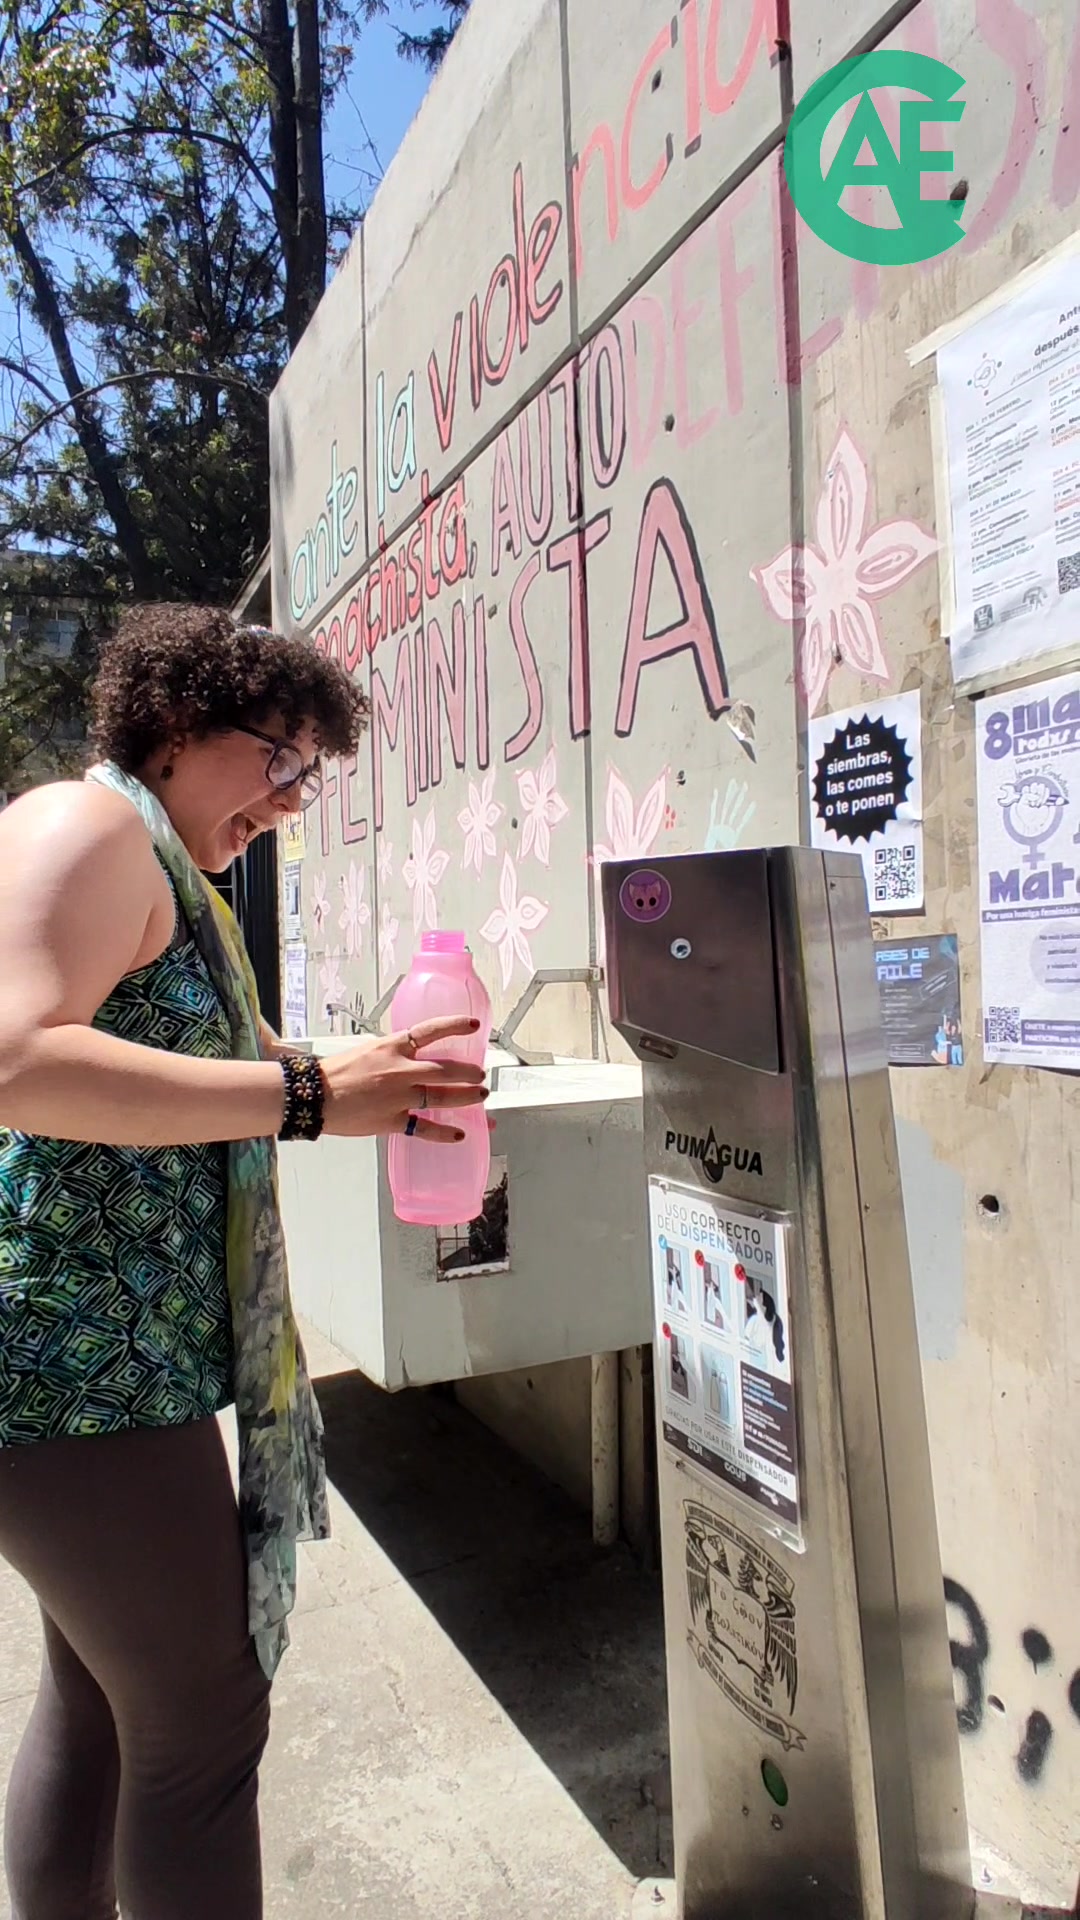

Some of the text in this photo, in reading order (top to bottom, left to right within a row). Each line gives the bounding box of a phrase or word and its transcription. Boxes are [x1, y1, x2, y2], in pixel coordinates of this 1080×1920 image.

[291, 0, 789, 621] ante la violencia
[320, 477, 732, 857] FEMINISTA
[846, 733, 870, 750] Las
[827, 750, 892, 775] siembras,
[826, 771, 893, 796] las comes
[825, 792, 894, 816] o te ponen
[911, 947, 930, 960] DE
[665, 1130, 763, 1176] PUMAGUA
[657, 1215, 774, 1267] DEL DISPENSADOR
[665, 1203, 761, 1245] USO CORRECTO
[737, 1449, 788, 1486] DISPENSADOR
